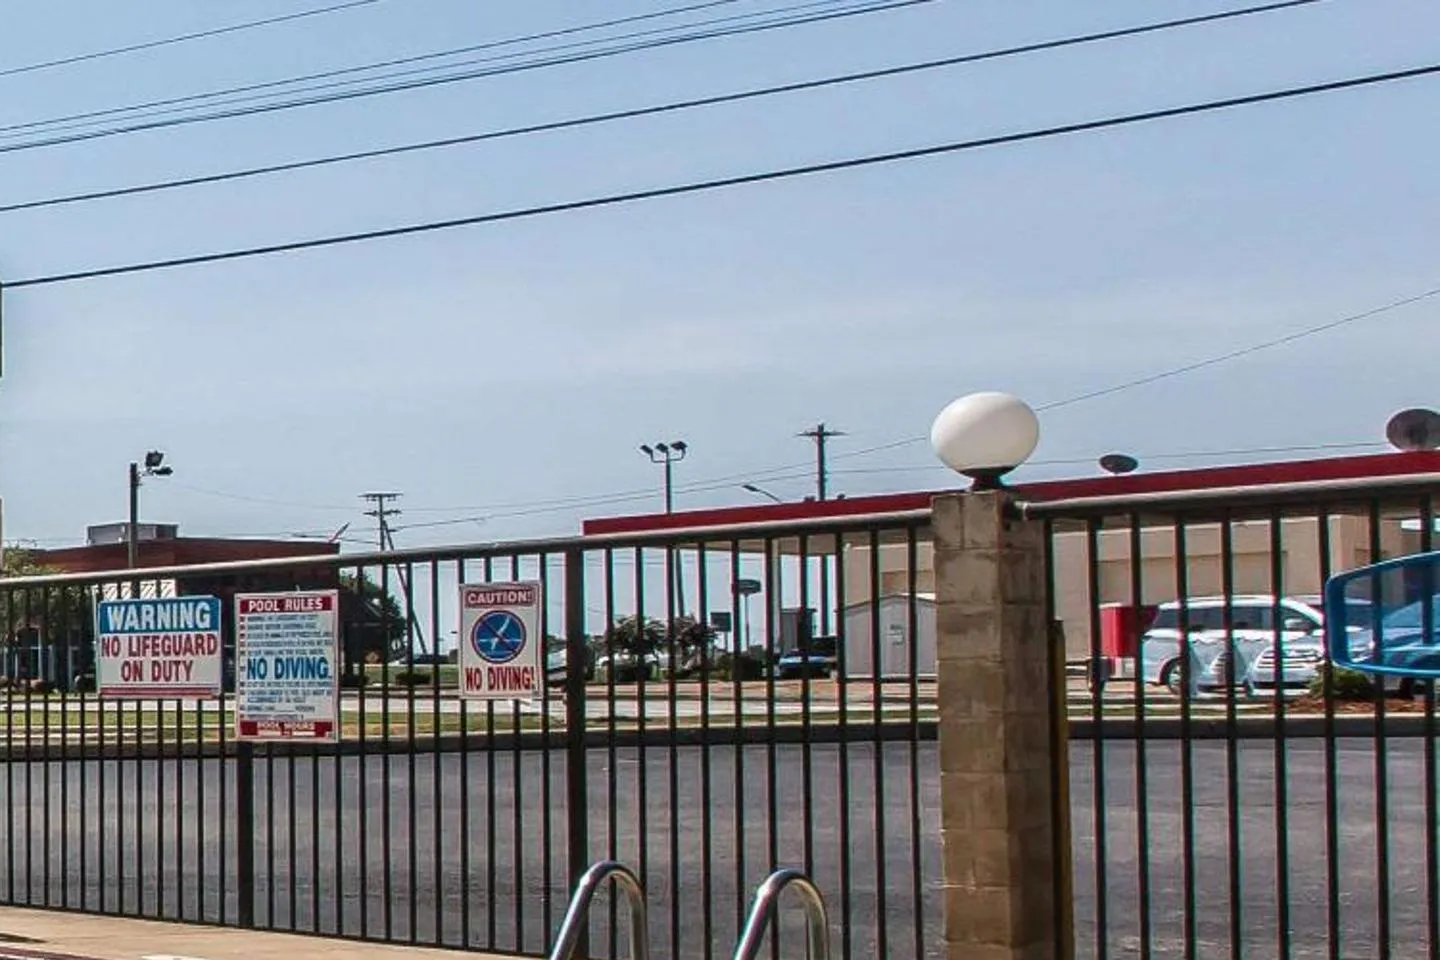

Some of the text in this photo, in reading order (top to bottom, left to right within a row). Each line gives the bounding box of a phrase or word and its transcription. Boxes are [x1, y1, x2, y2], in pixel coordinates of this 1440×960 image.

[248, 597, 324, 612] POOL RULES
[467, 590, 532, 604] CAUTION!
[107, 602, 211, 631] WARNING
[101, 634, 218, 657] NO LIFEGUARD
[121, 660, 193, 682] ON DUTY
[247, 657, 268, 680] NO
[465, 665, 536, 691] NO DIVING!
